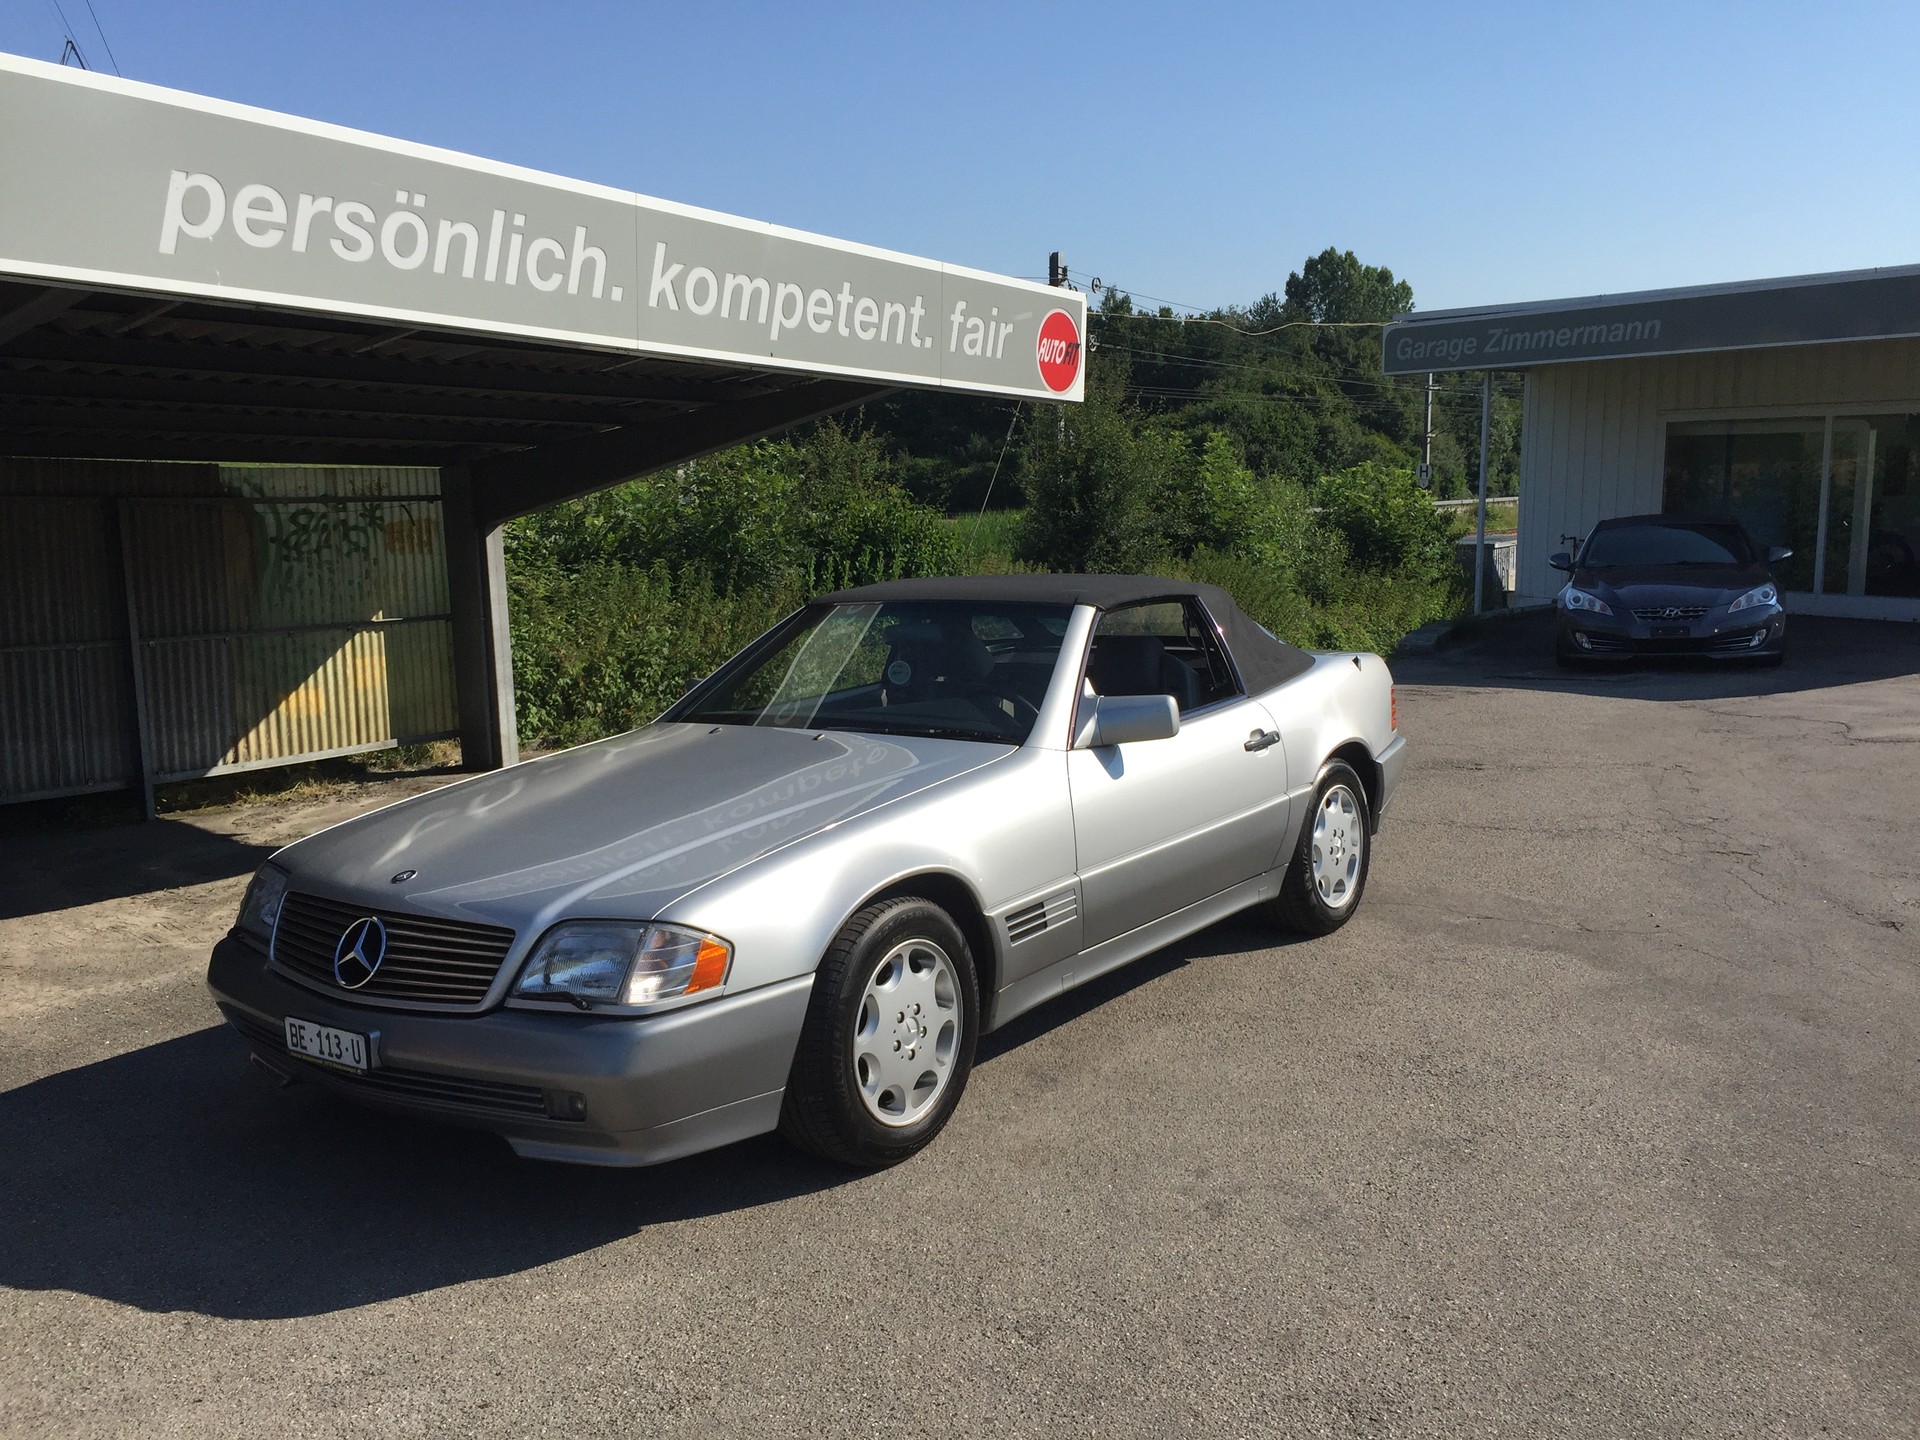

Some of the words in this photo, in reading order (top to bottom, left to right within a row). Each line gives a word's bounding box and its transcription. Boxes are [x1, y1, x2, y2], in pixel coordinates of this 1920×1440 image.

[159, 169, 624, 301] persönlich.
[648, 241, 933, 349] kompetent.
[949, 300, 1014, 360] fair
[1396, 336, 1477, 362] Garage
[1484, 318, 1662, 354] Zimmermann
